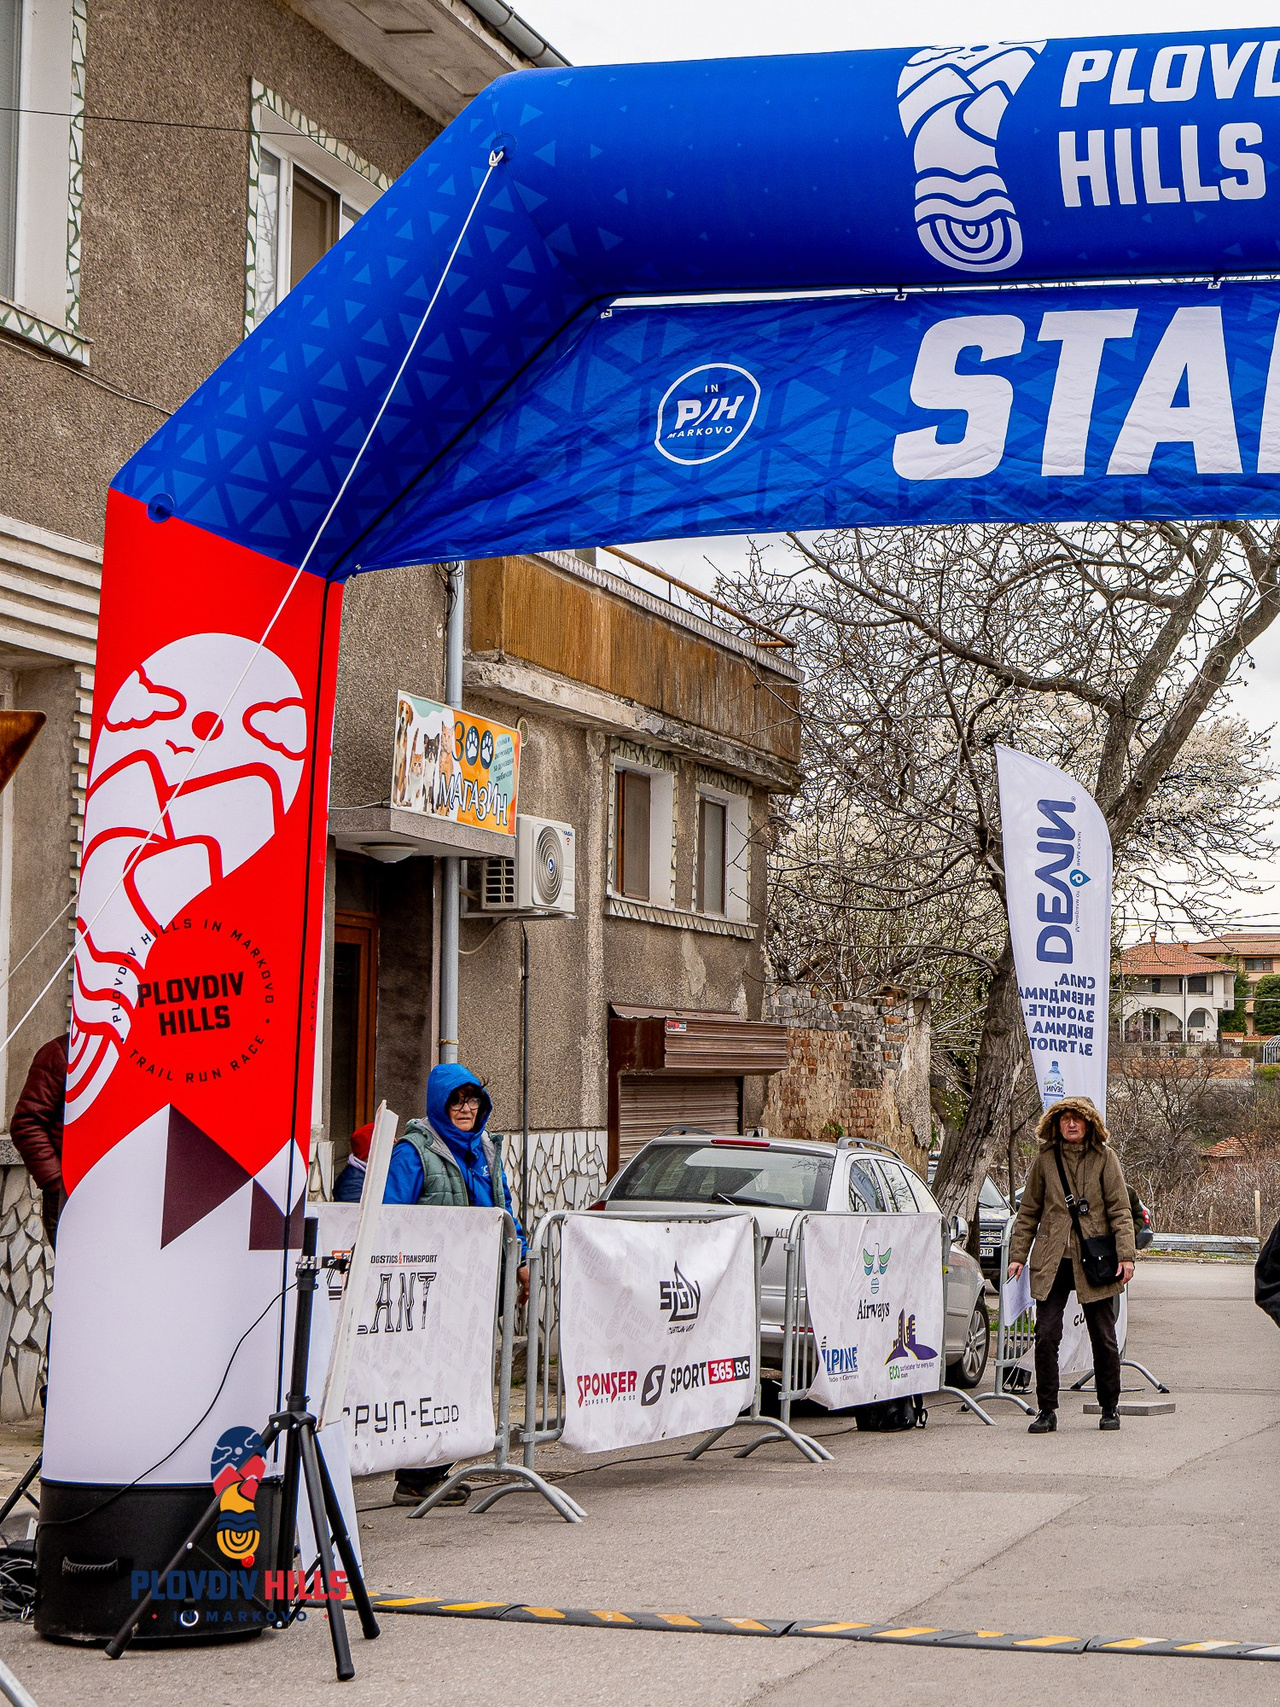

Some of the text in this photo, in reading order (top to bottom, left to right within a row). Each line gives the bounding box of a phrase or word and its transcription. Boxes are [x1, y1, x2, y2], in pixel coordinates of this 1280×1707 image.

[1058, 121, 1266, 208] HILLS
[704, 383, 719, 393] IN
[674, 395, 745, 430] P/H
[667, 425, 733, 440] MARKOVO
[439, 772, 508, 826] МАГАЗИН
[112, 947, 137, 1023] PLOVDIV
[141, 918, 192, 945] HILLS
[204, 919, 222, 932] IN
[230, 929, 274, 1003] MARKOVO
[137, 971, 244, 1008] PLOVDIV
[159, 1004, 231, 1036] HILLS
[129, 1034, 265, 1083] TRAIL RUN RACE
[358, 1272, 437, 1335] ANT
[857, 1299, 890, 1322] Airways
[577, 1371, 638, 1408] SPONSER
